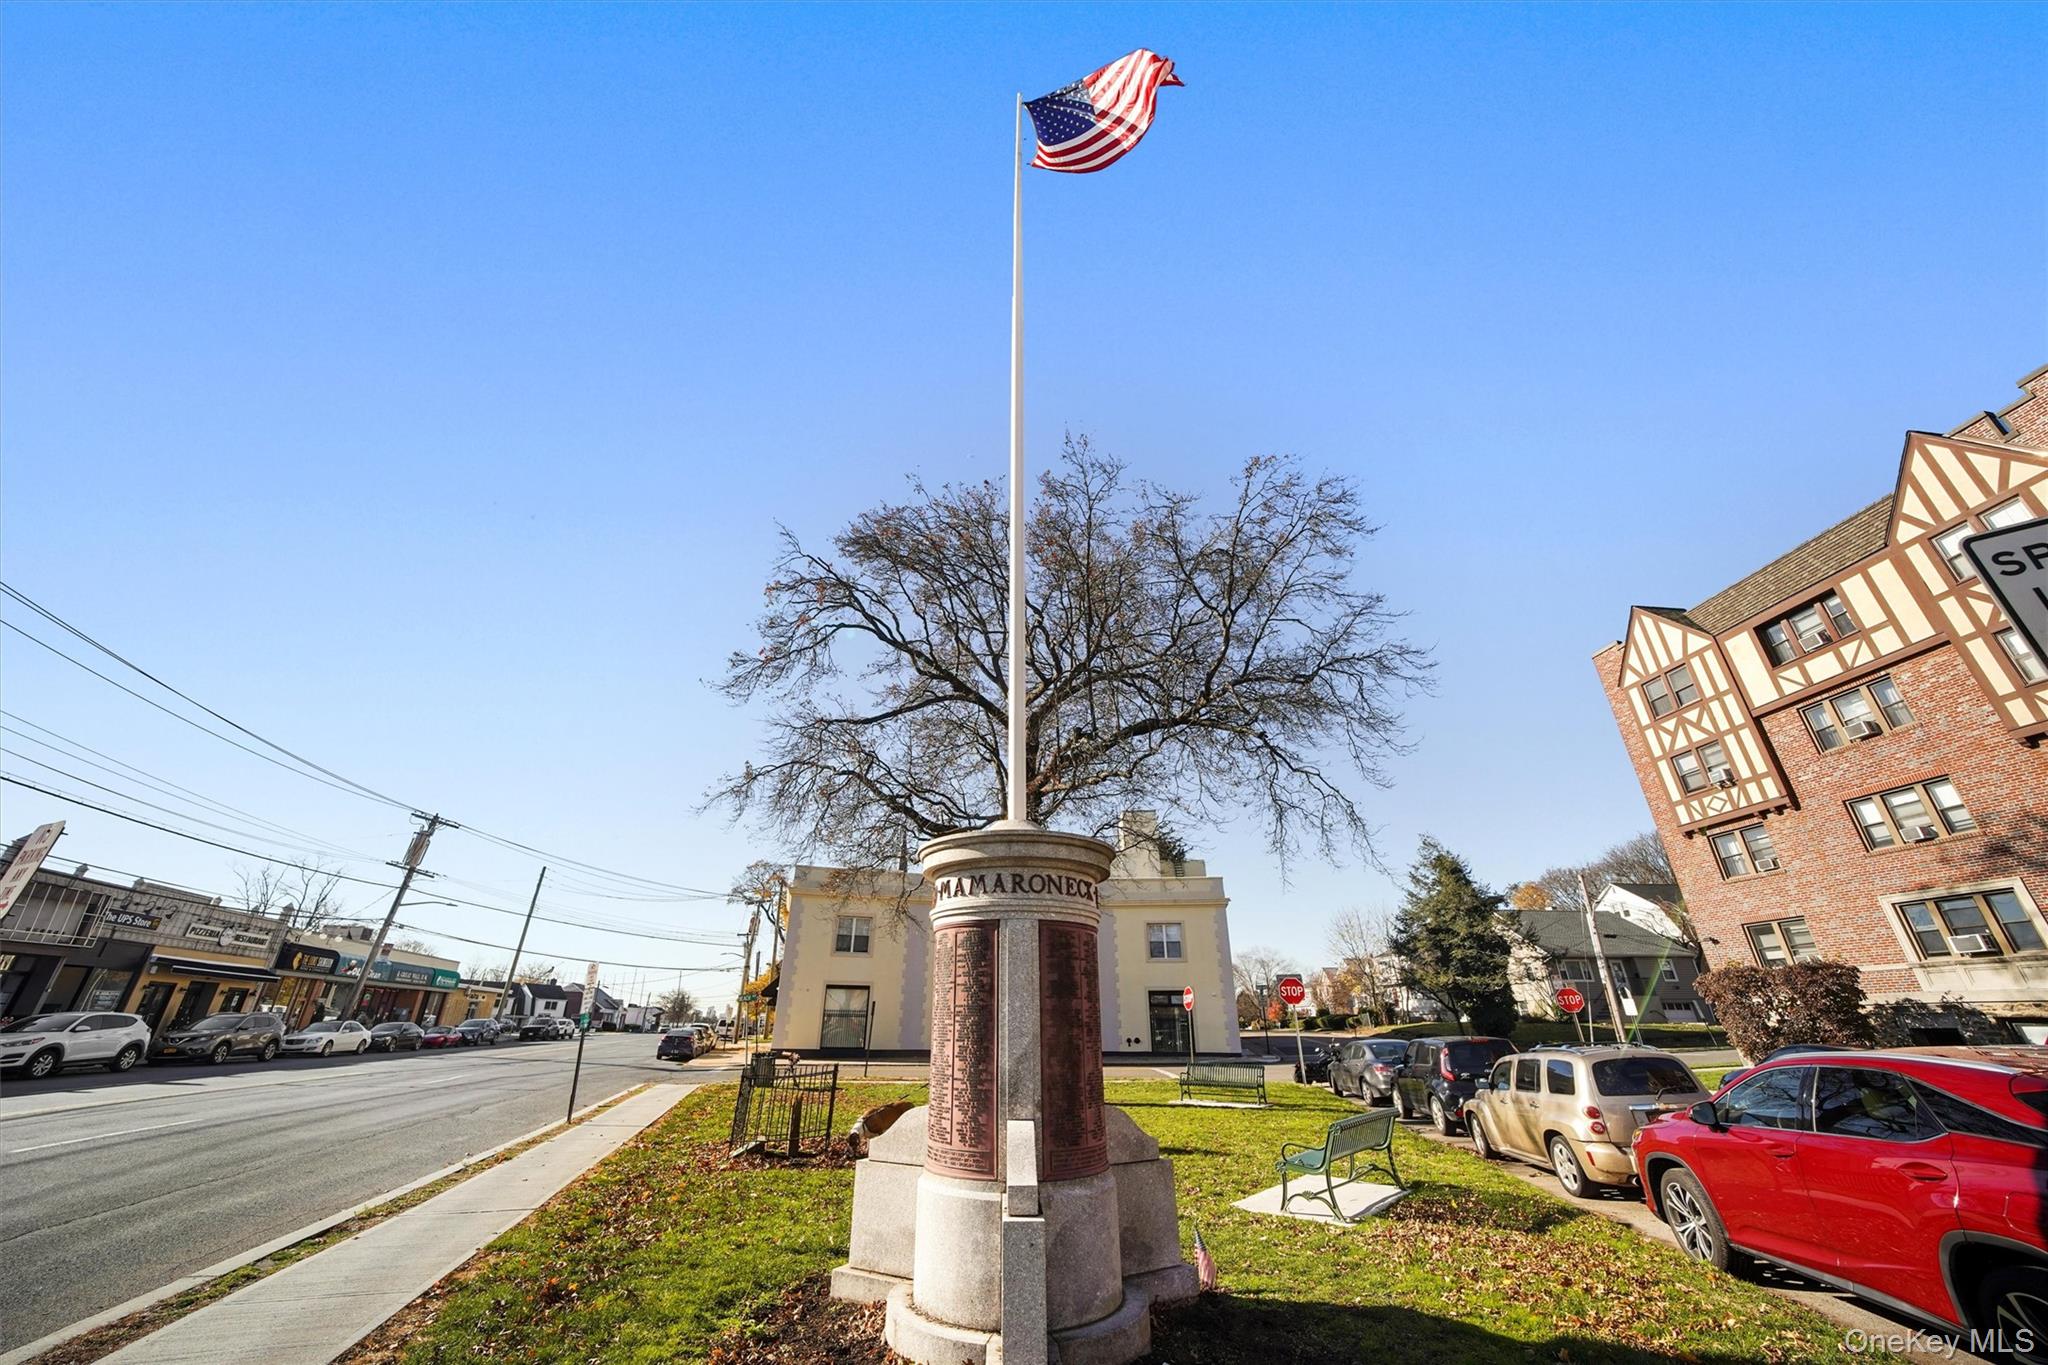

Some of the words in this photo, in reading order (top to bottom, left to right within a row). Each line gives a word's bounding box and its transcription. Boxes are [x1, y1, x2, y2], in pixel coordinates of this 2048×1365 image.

[940, 873, 1093, 902] MAMARONECK
[104, 911, 117, 922] The
[117, 913, 134, 925] UPS
[132, 916, 152, 928] Store
[189, 926, 221, 939] PIZZERIA
[1280, 986, 1303, 997] STOP
[1558, 994, 1581, 1006] STOP
